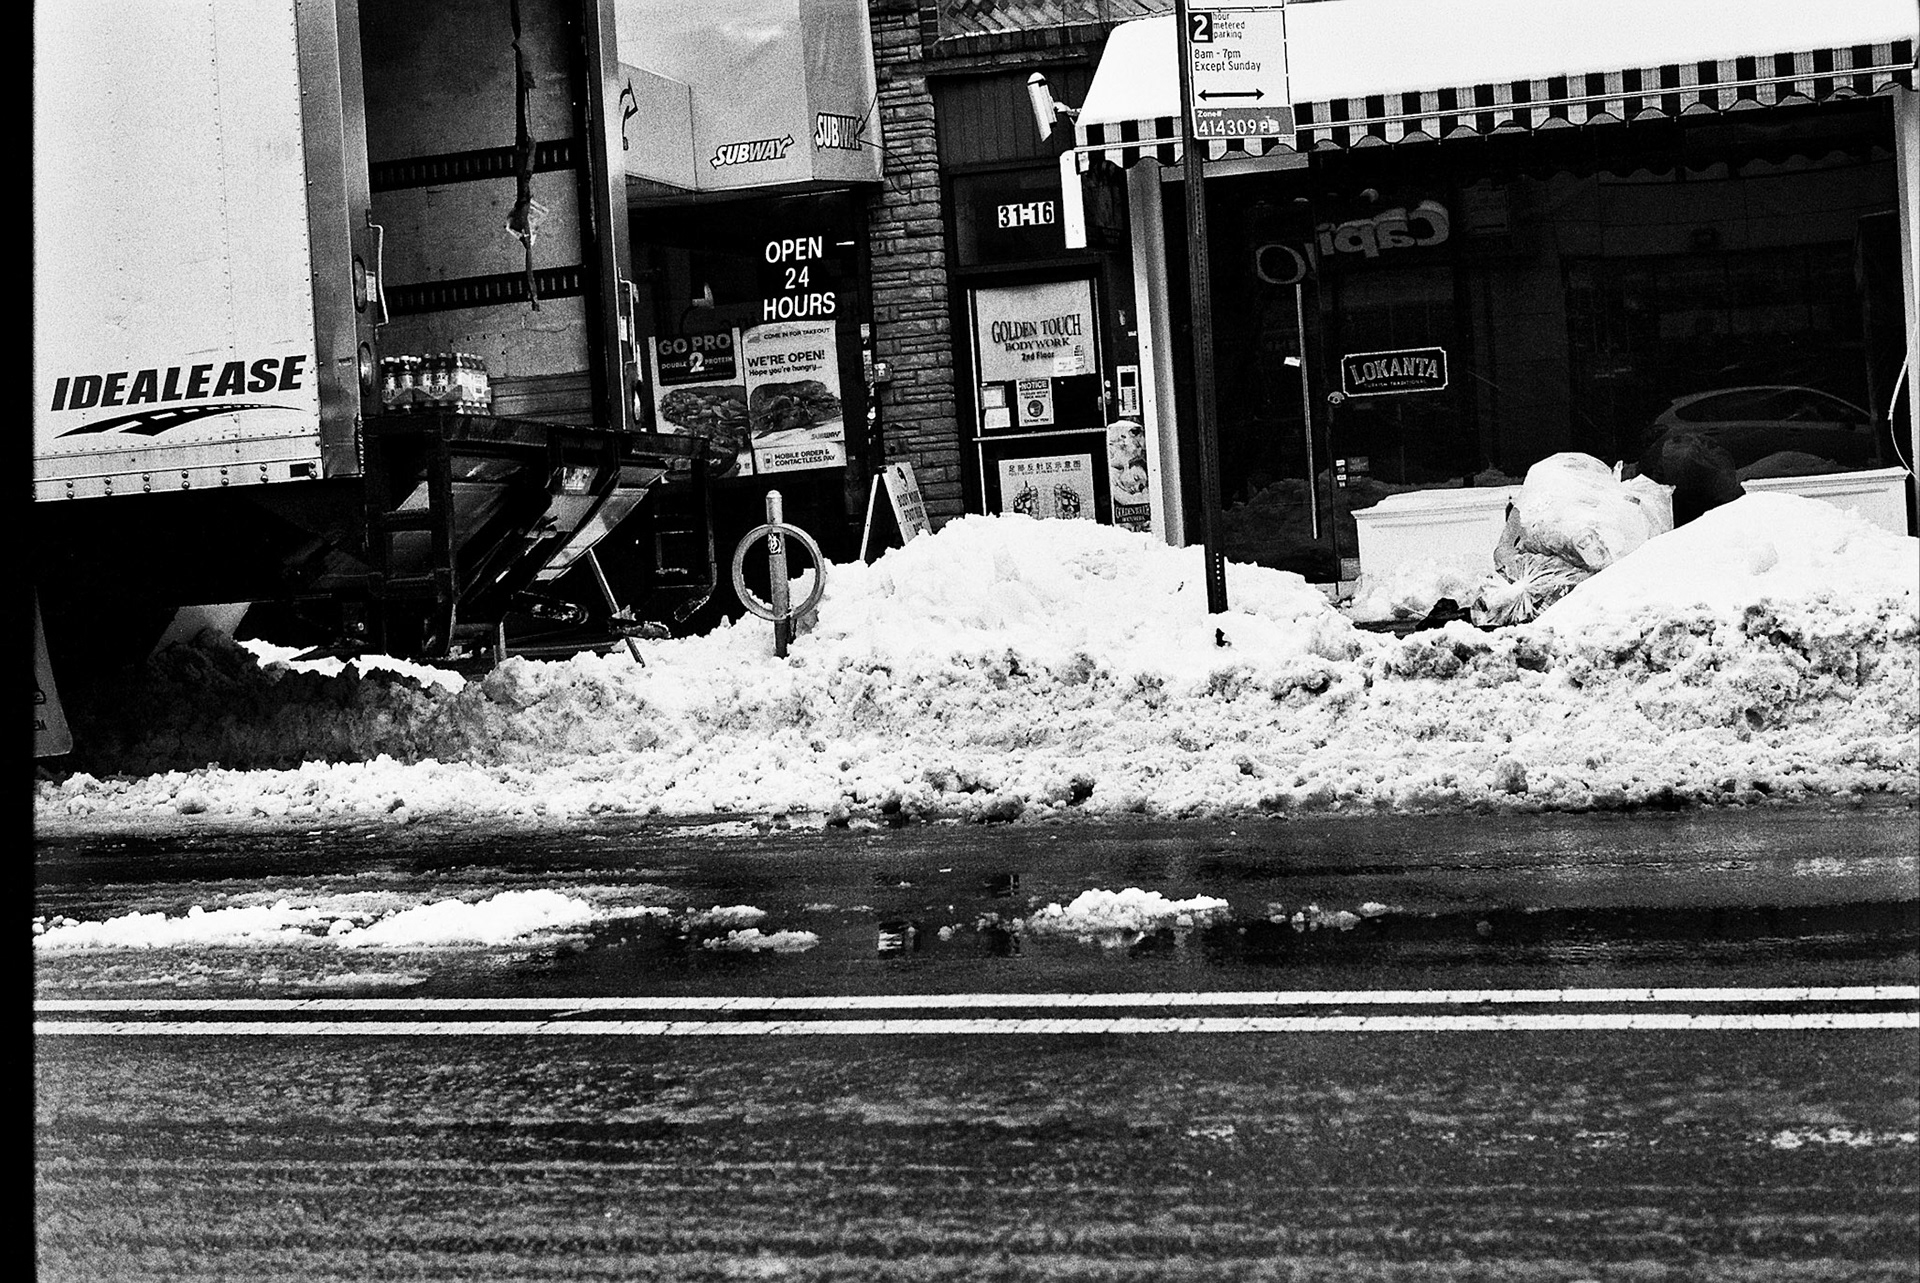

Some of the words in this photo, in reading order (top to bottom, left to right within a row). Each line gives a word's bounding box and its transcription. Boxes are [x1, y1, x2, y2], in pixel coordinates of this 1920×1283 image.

[1213, 12, 1230, 20] hour
[1193, 14, 1209, 41] 2
[1213, 21, 1245, 29] metered
[1213, 30, 1242, 39] parking
[1194, 48, 1214, 59] 8am
[1222, 48, 1241, 60] 7pm
[1194, 61, 1226, 72] Except
[1228, 61, 1261, 72] Sunday
[1198, 119, 1257, 135] 414309
[710, 134, 794, 169] SUBWAY
[1000, 202, 1053, 227] 31-16
[765, 236, 823, 263] OPEN
[784, 266, 810, 290] 24
[763, 292, 836, 321] HOURS
[991, 320, 1037, 344] GOLDEN
[1040, 313, 1082, 336] TOUCH
[658, 338, 688, 356] GO
[691, 333, 731, 352] PRO
[661, 361, 687, 370] DOUBLE
[704, 356, 733, 365] PROTEIN
[747, 354, 785, 368] WE'RE
[788, 350, 825, 363] OPEN!
[1021, 352, 1035, 362] 2nd
[1036, 351, 1055, 360] Floor
[749, 368, 768, 377] Hope
[769, 366, 791, 376] you're
[1349, 357, 1438, 385] LOKANTA
[51, 355, 307, 411] IDEALEASE
[1021, 381, 1048, 390] NOTICE
[775, 452, 799, 460] MOBILE
[800, 450, 824, 458] ORDER
[775, 457, 823, 467] CONTACTLESS
[823, 455, 836, 463] PAY
